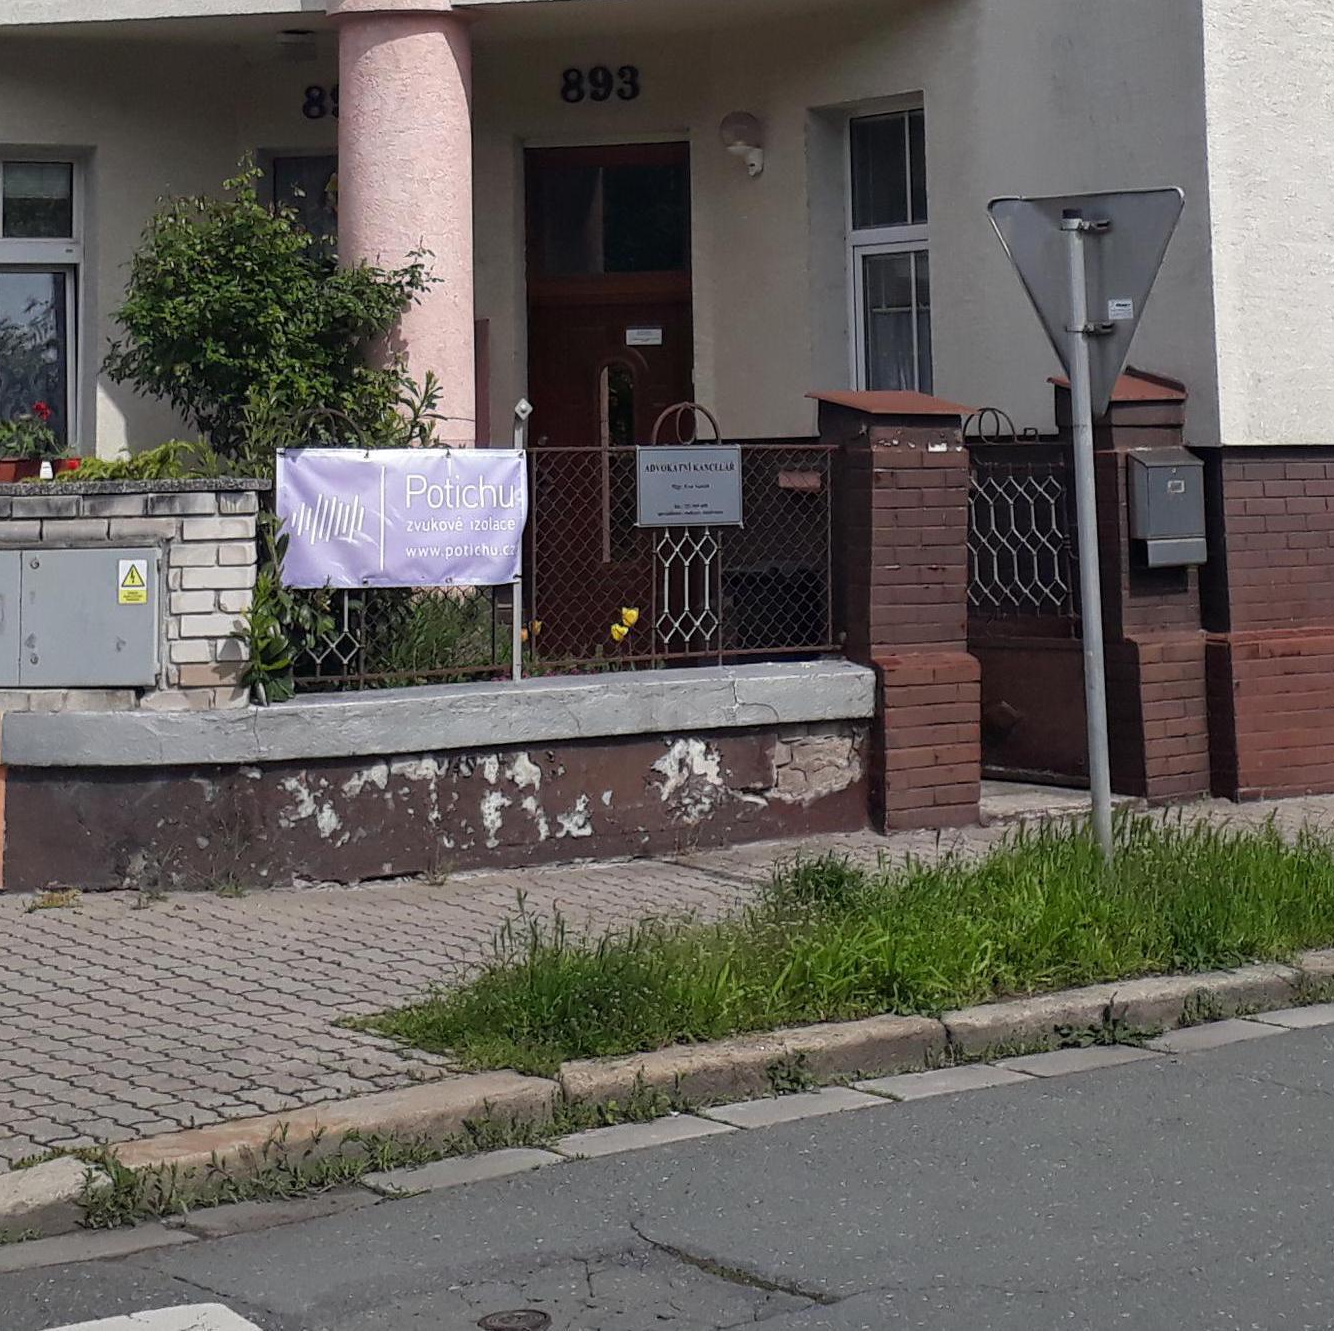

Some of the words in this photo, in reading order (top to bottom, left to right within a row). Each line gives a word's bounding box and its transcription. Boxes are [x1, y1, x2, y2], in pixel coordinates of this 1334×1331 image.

[560, 64, 641, 104] 893
[406, 474, 515, 510] Potichu
[406, 517, 463, 533] zvukové
[470, 517, 516, 532] izolace
[405, 544, 516, 560] www.potichu.cz
